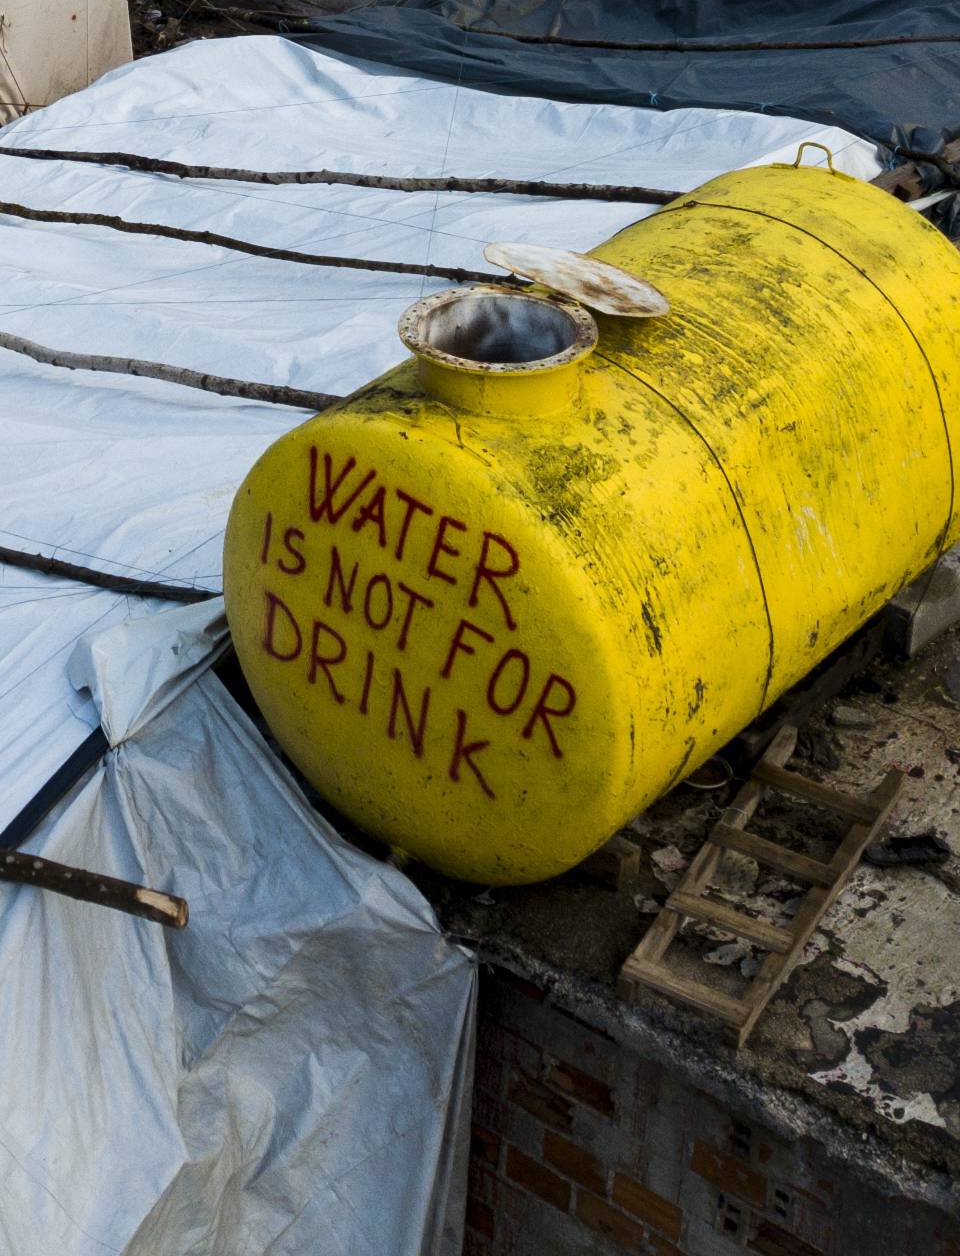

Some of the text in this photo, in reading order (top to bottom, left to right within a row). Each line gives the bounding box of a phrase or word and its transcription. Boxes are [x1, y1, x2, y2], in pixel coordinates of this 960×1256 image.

[261, 512, 576, 759] IS NOT FOR
[309, 446, 520, 630] WATER
[263, 590, 495, 799] DRINK
